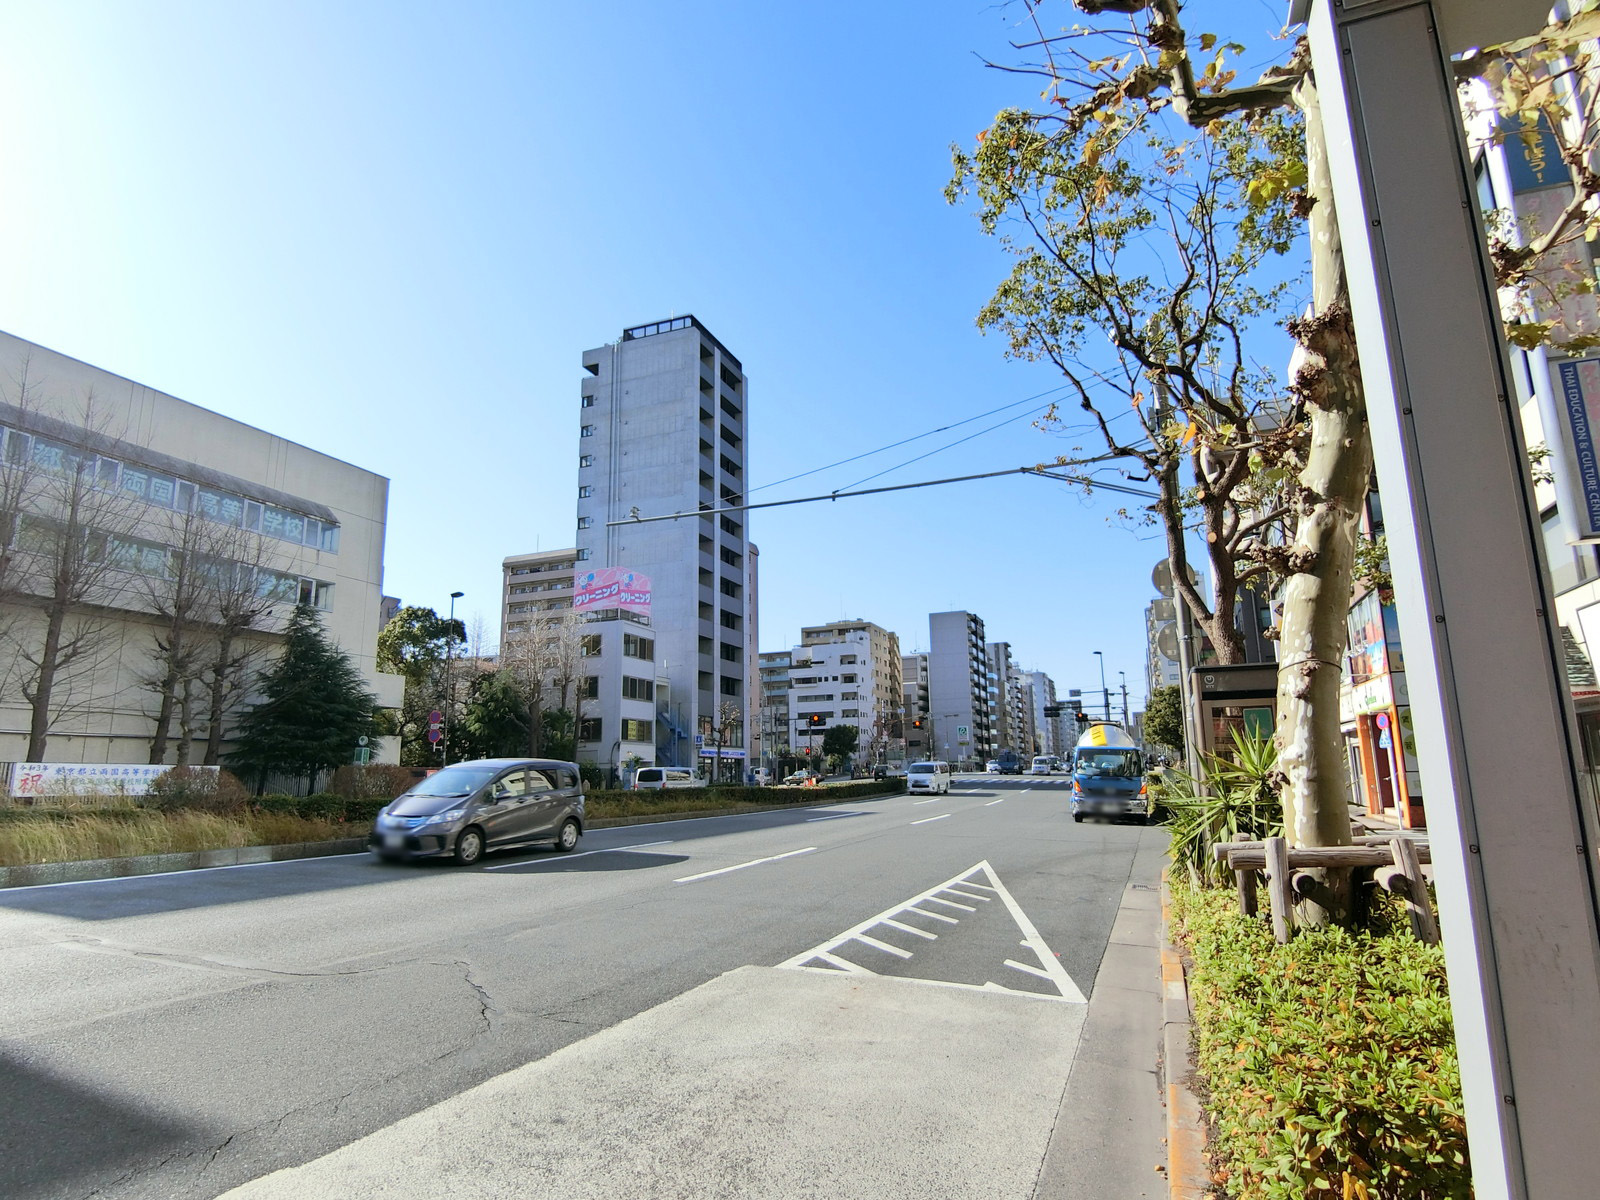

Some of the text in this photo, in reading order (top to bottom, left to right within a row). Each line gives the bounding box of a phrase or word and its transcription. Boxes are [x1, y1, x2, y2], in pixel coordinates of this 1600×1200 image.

[1564, 366, 1577, 388] THAI
[1568, 389, 1588, 440] EDUCATION
[1581, 451, 1598, 491] CULTURE
[575, 582, 619, 606] クリーニング
[620, 591, 651, 603] クリーニング
[18, 773, 45, 795] 祝
